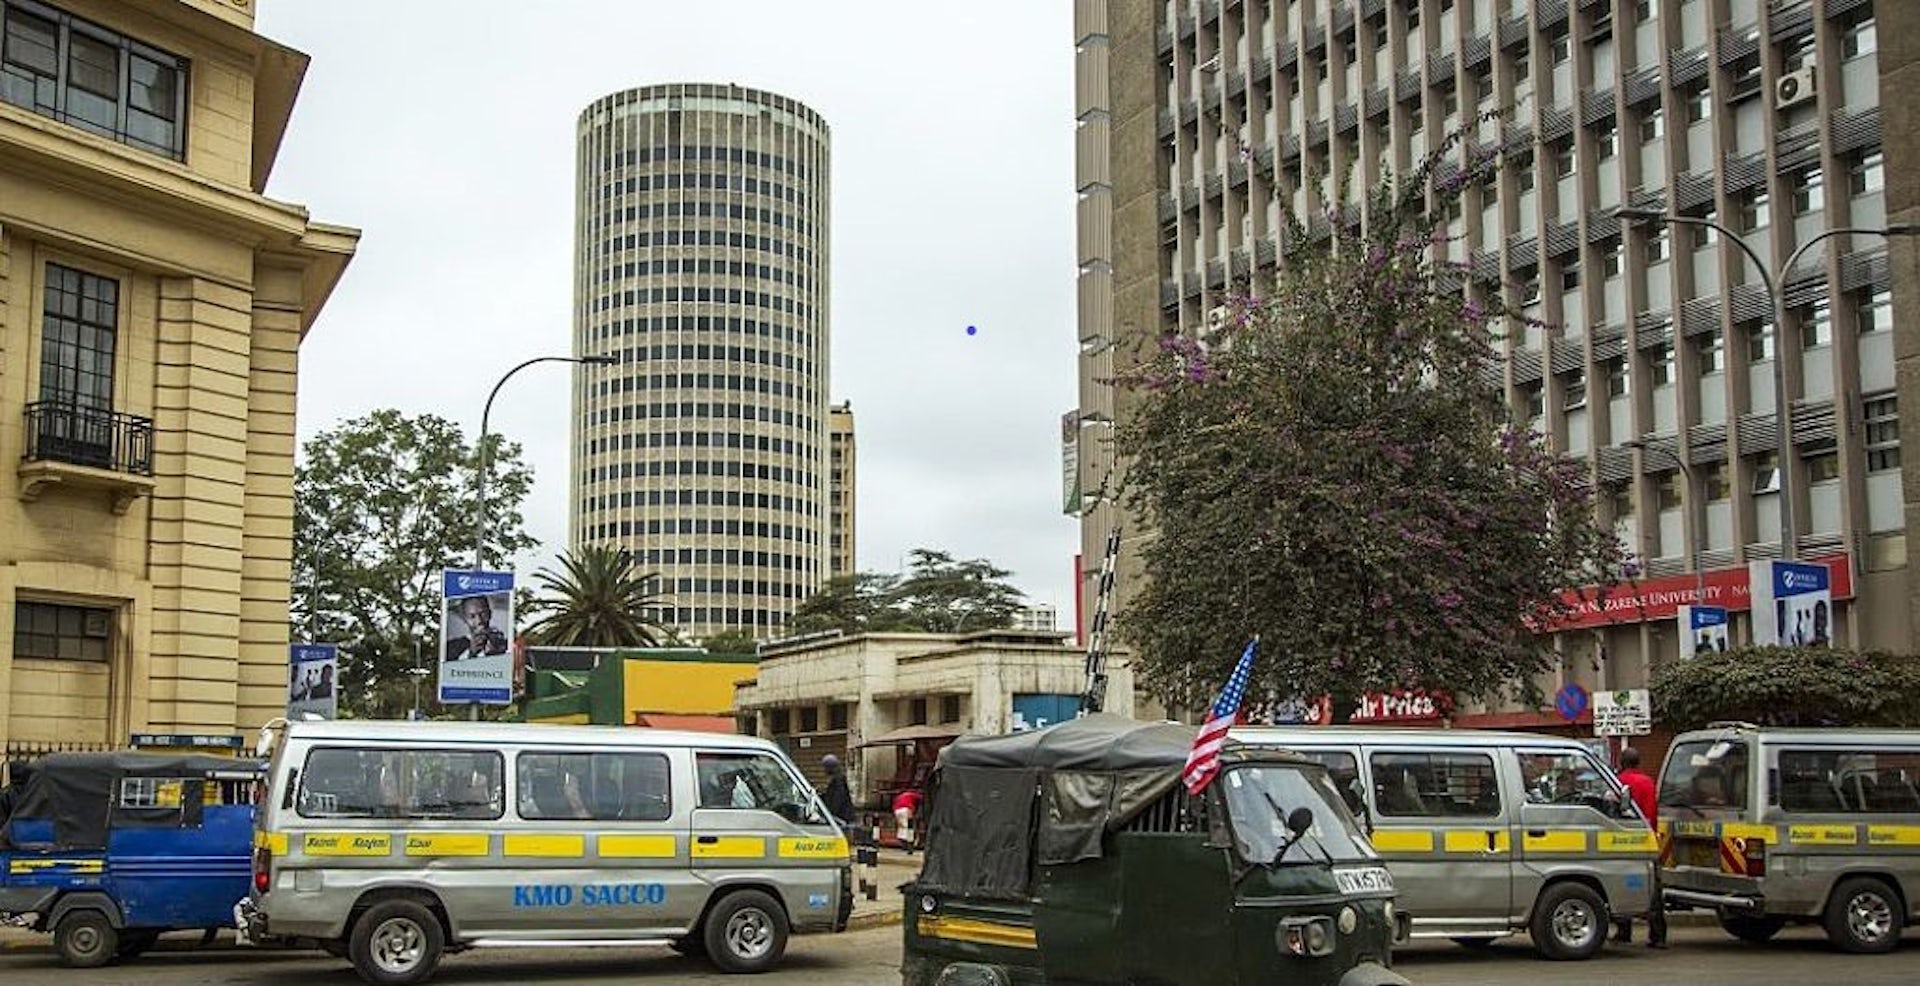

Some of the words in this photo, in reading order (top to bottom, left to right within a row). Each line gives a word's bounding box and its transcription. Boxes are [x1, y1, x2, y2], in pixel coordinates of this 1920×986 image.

[1587, 595, 1646, 614] NZARENE
[1382, 691, 1436, 716] Price
[514, 884, 573, 907] KMO
[582, 883, 666, 906] SACCO
